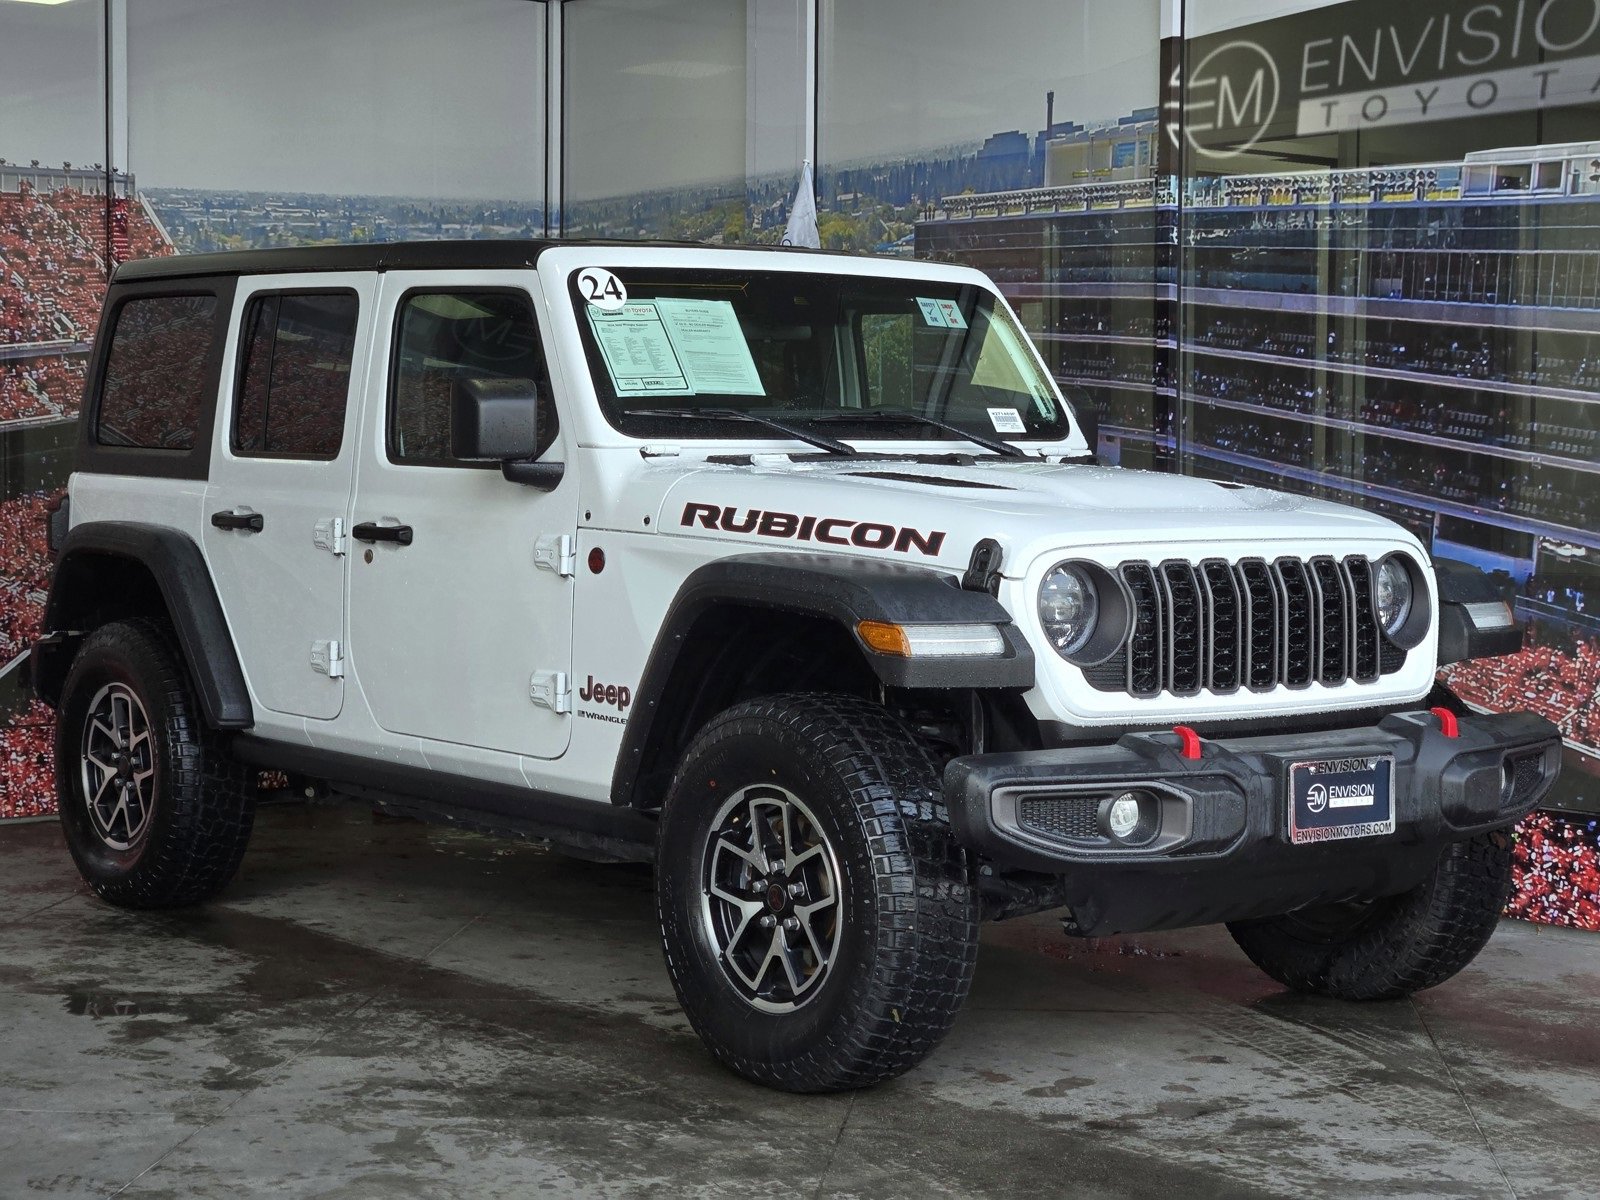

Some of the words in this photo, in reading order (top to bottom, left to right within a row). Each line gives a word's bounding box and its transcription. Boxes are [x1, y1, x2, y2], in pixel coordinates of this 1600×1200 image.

[1320, 67, 1600, 128] TOYOT
[582, 275, 623, 301] 24
[680, 502, 946, 557] RUBICON
[579, 675, 631, 712] Jeep
[585, 711, 628, 725] WRANGLE
[1318, 758, 1368, 774] ENVISION
[1329, 784, 1375, 798] ENVISION
[1296, 822, 1392, 842] ENVISIONMOTORS.COM
